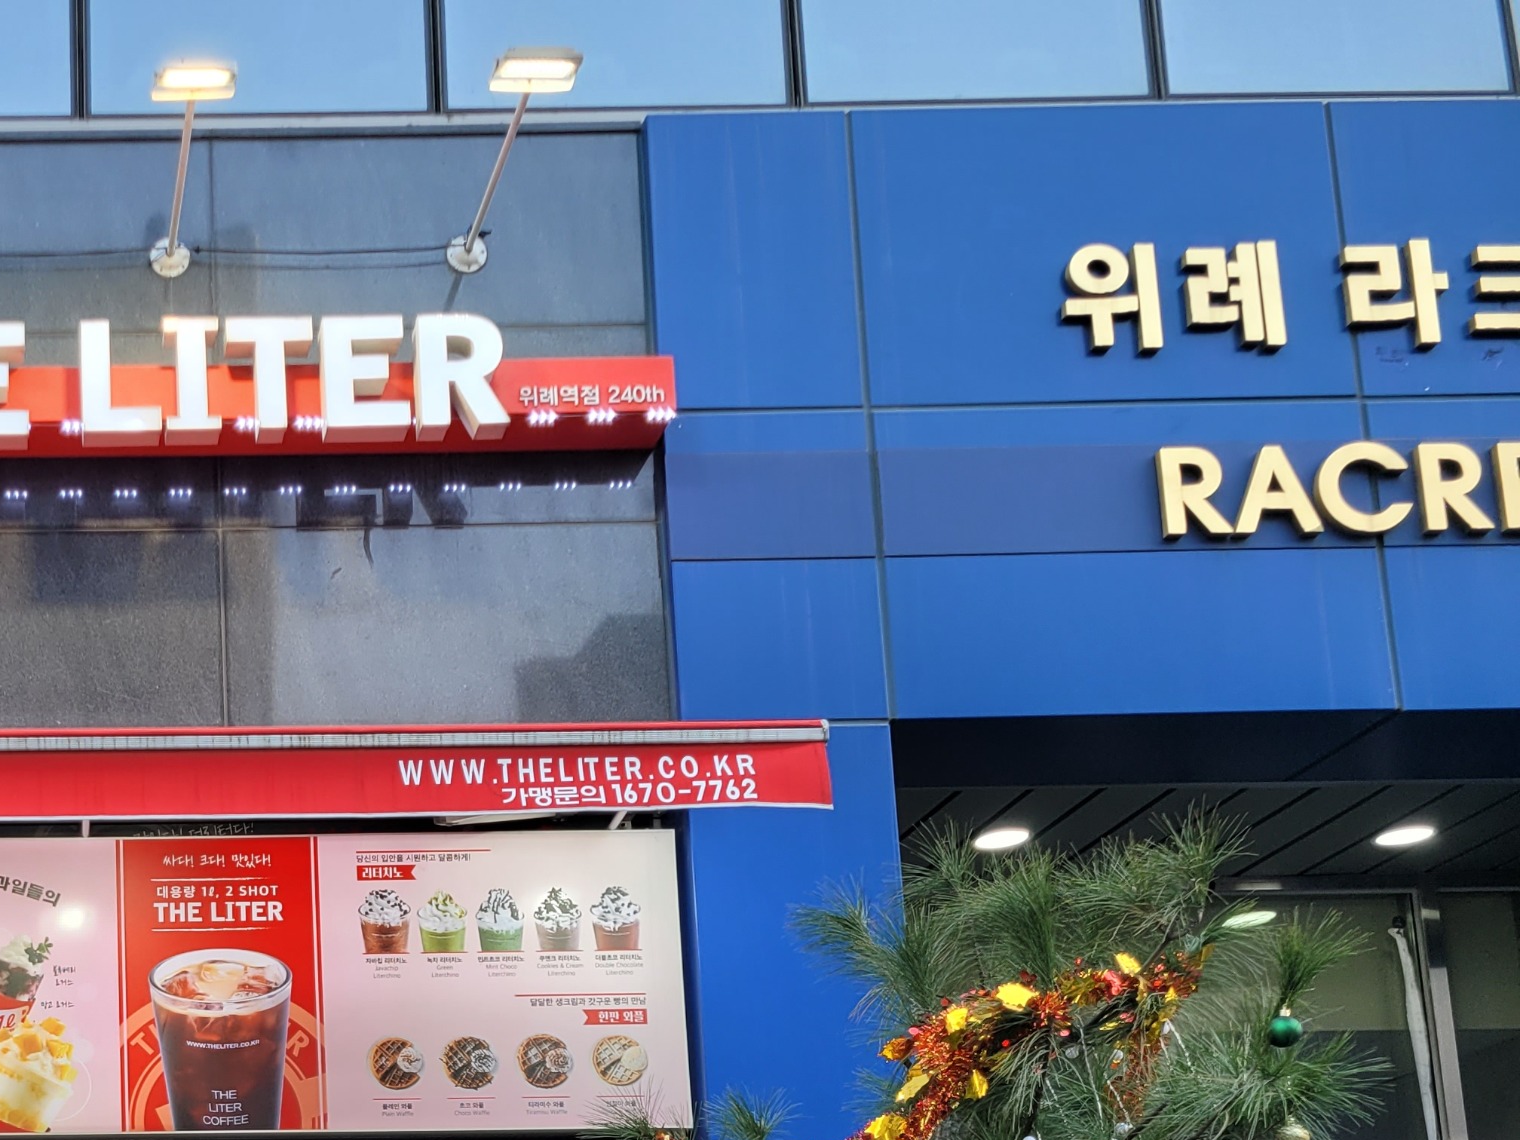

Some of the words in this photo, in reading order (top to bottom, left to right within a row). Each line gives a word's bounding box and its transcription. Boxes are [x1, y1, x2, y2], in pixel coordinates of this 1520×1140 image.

[1060, 239, 1288, 357] 위례
[80, 313, 511, 447] LITER
[519, 385, 601, 408] 위례역점
[607, 384, 666, 406] 240th
[500, 785, 606, 807] 가맹문의
[611, 778, 758, 805] 1670-7762
[163, 854, 194, 868] 싸다!
[199, 854, 225, 867] 크다!
[232, 853, 271, 868] 맛있다!
[356, 854, 378, 863] 당신의
[406, 854, 436, 862] 시원하고
[362, 867, 404, 878] 리터치노
[156, 885, 196, 898] 대용량
[225, 886, 233, 896] 2
[239, 885, 278, 896] SHOT
[153, 902, 203, 923] THE
[210, 901, 283, 922] LITER
[530, 998, 553, 1007] 달달한
[623, 1011, 644, 1022] 와플
[211, 1089, 237, 1100] THE
[208, 1102, 242, 1113] LITER
[202, 1115, 249, 1126] COFFEE
